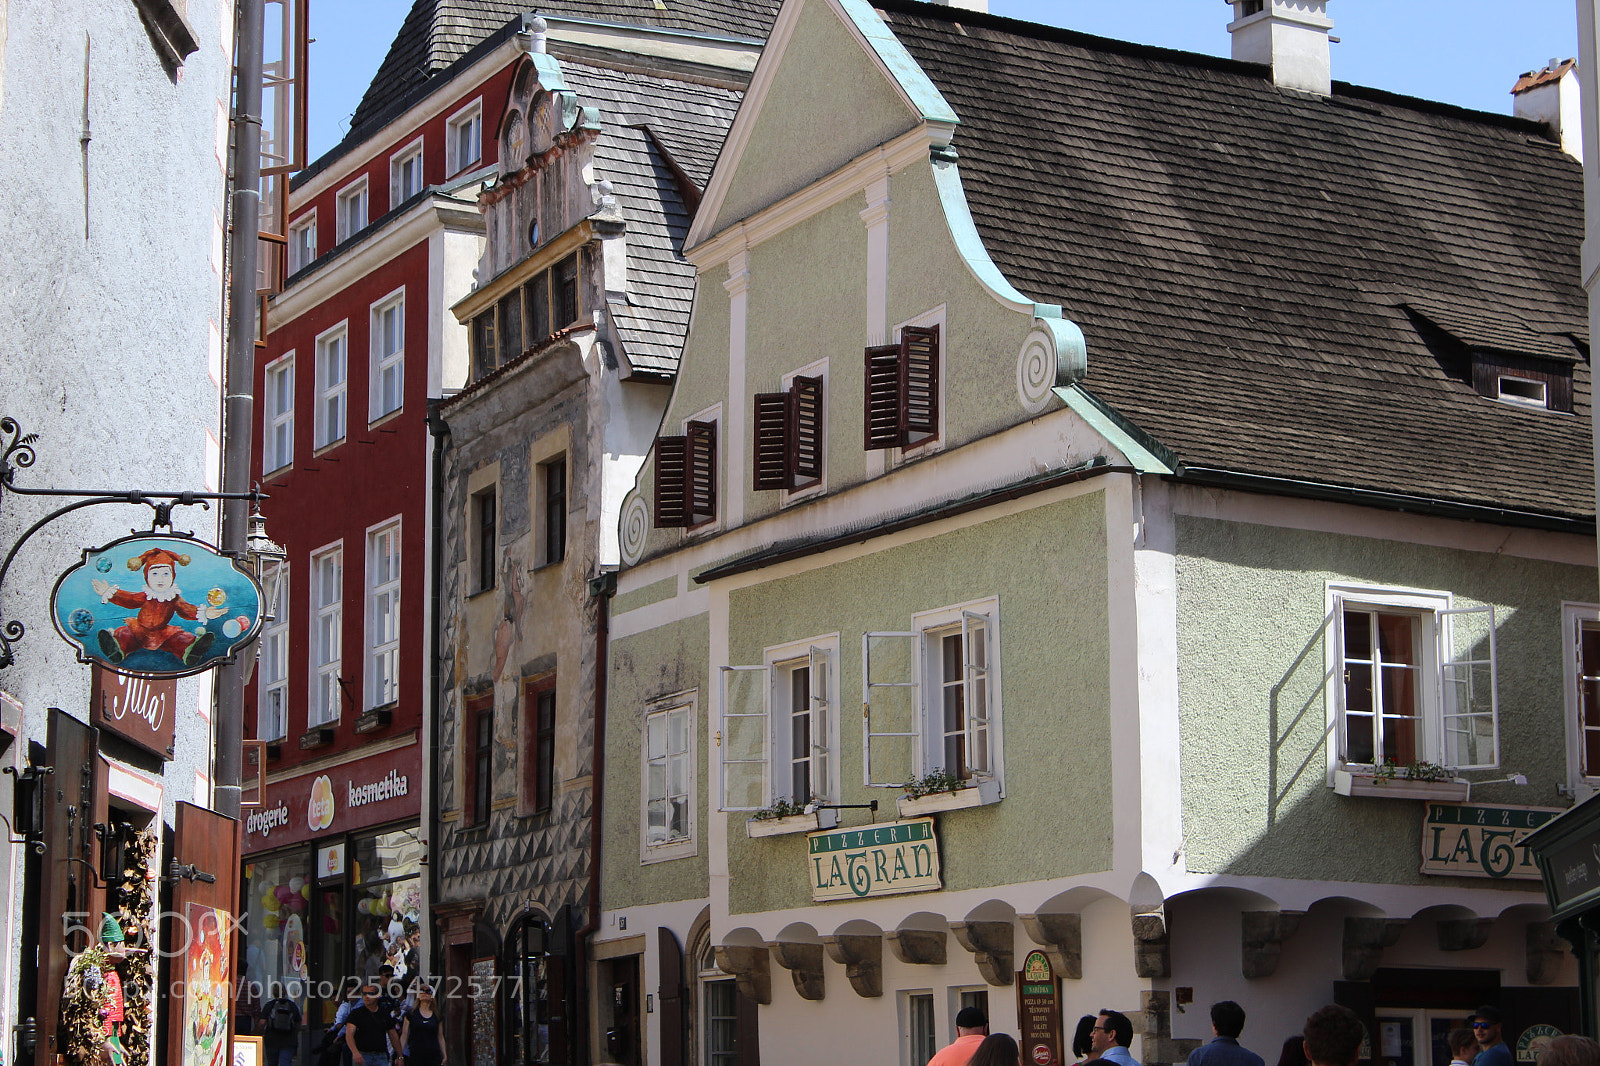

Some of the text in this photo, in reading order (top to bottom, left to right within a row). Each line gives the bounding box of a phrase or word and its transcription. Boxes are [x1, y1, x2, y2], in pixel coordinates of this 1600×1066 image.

[246, 768, 408, 838] drogerie teta kosmetika
[813, 823, 929, 852] PIZZERIA
[812, 843, 933, 897] LATRÁN
